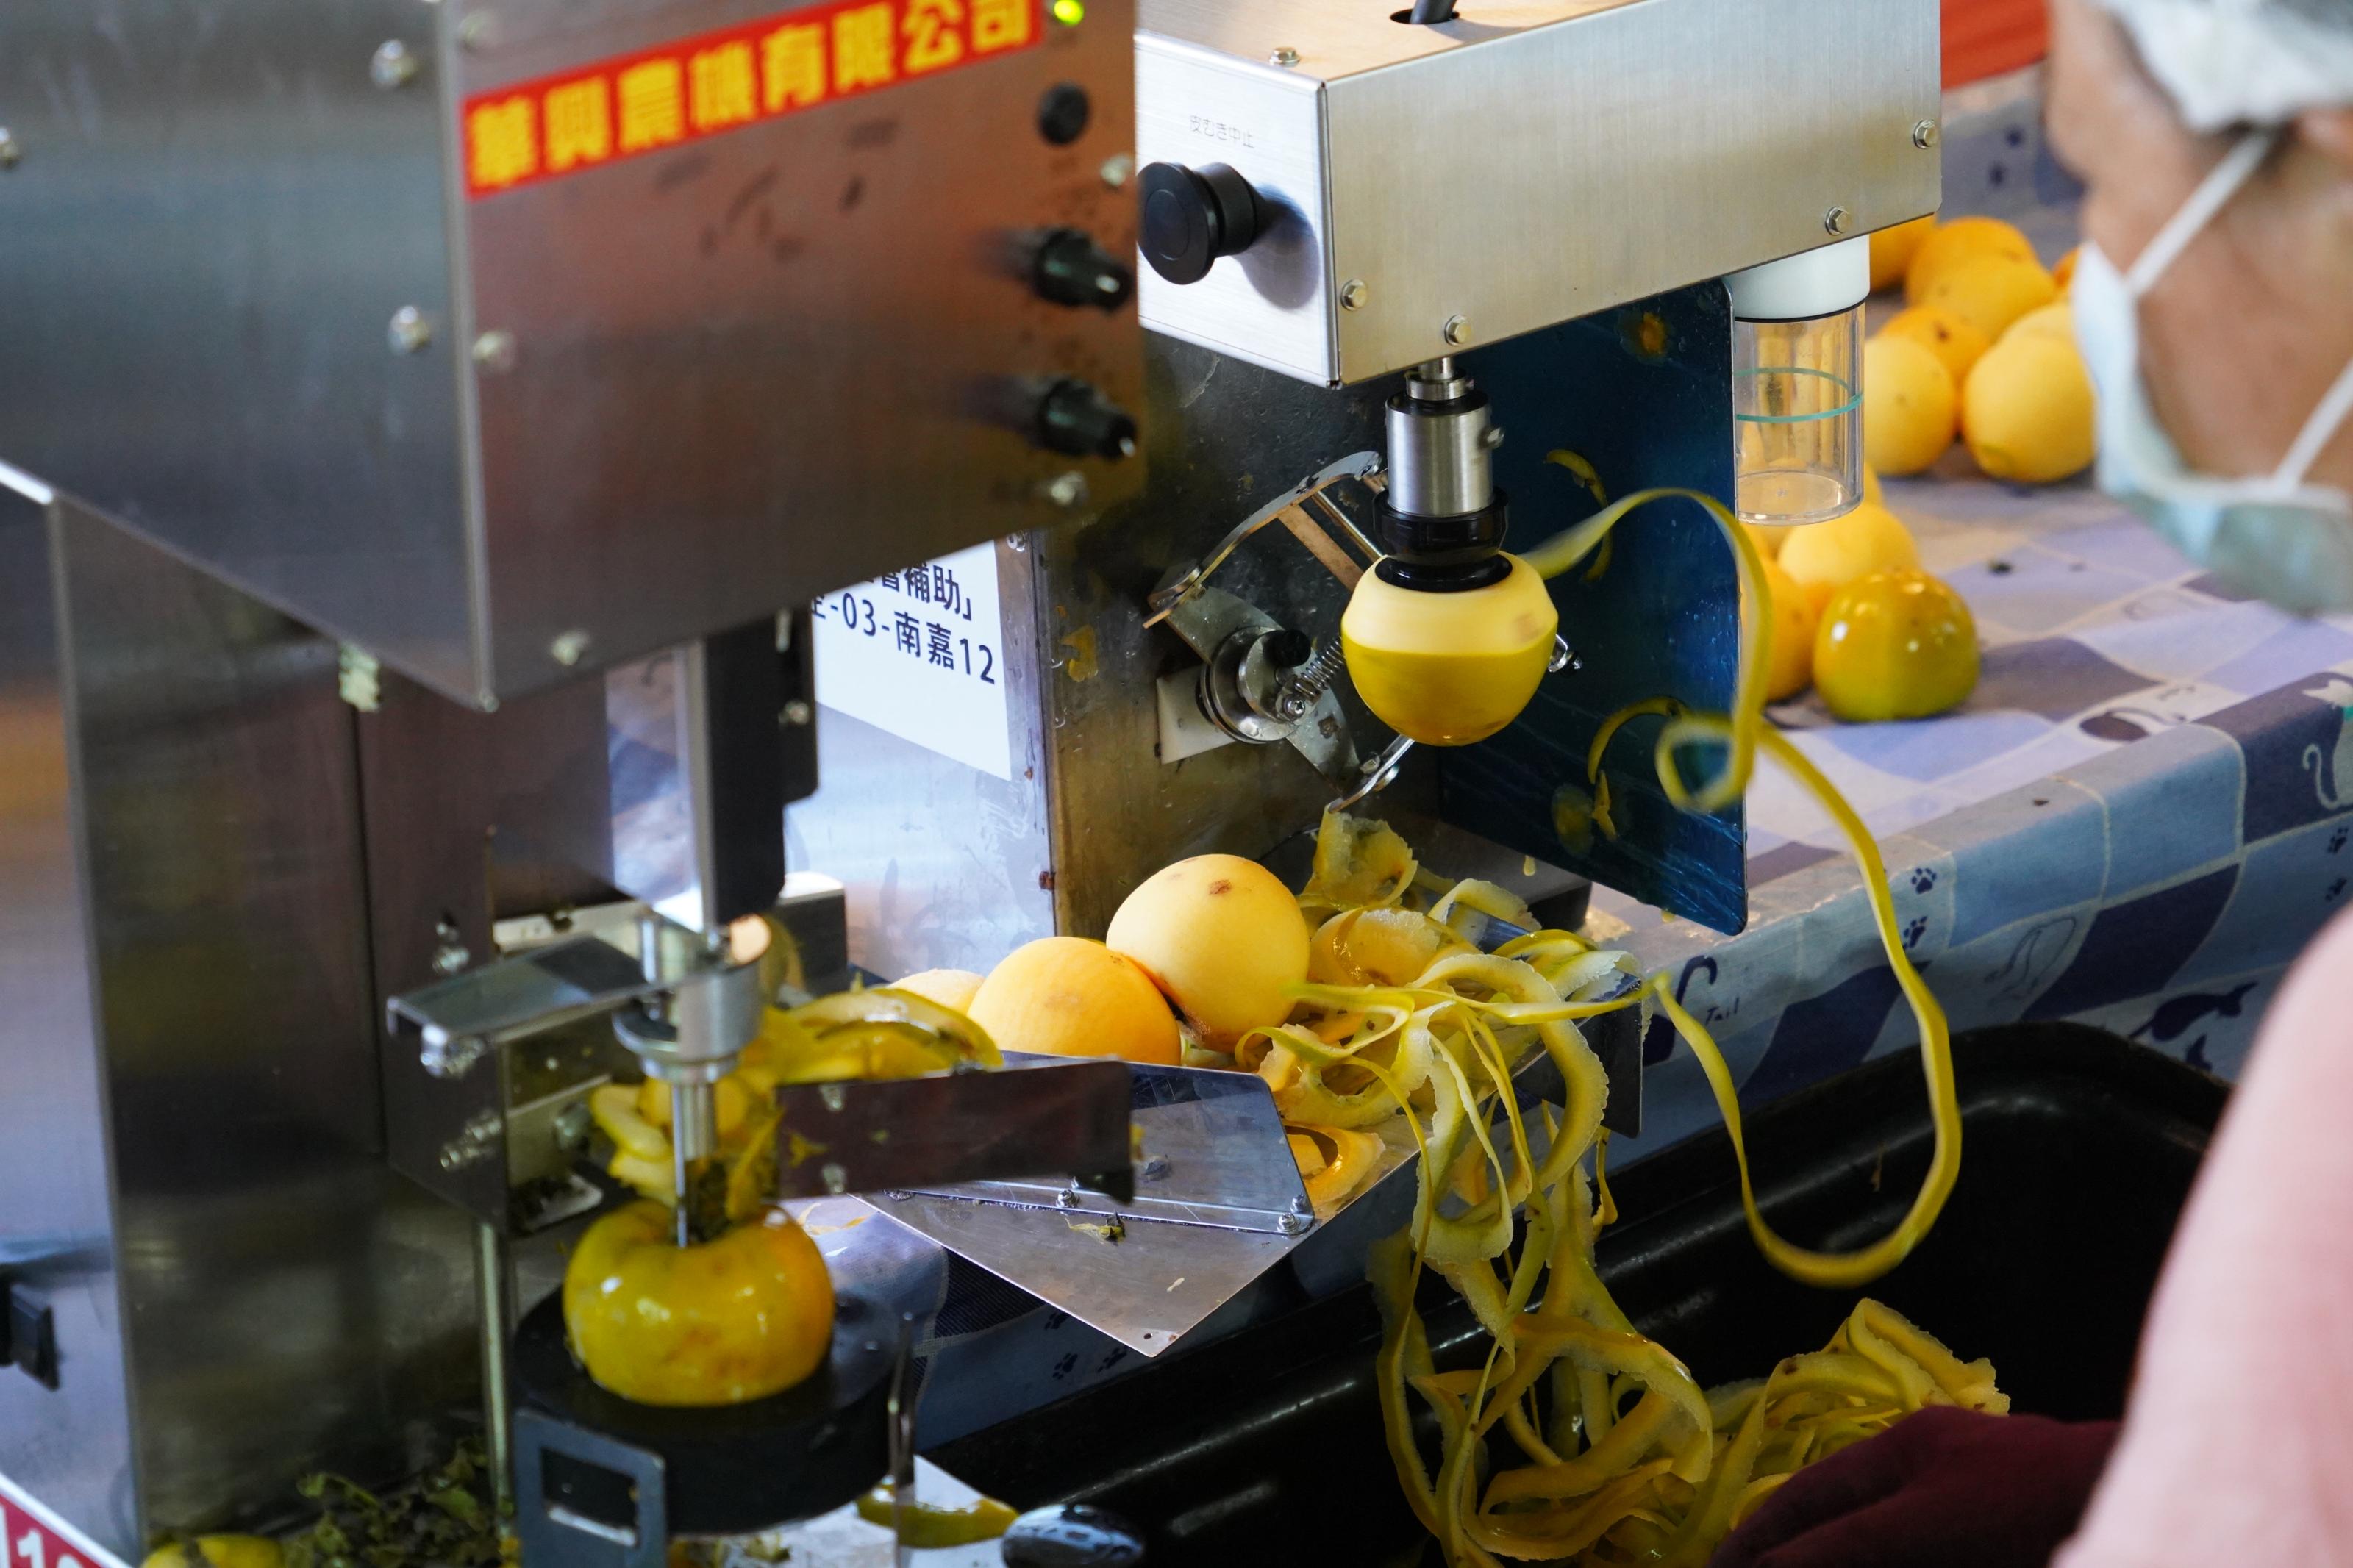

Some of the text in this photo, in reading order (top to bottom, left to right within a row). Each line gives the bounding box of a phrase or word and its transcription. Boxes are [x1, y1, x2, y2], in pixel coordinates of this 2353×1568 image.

[1190, 113, 1254, 149] 皮むき中止
